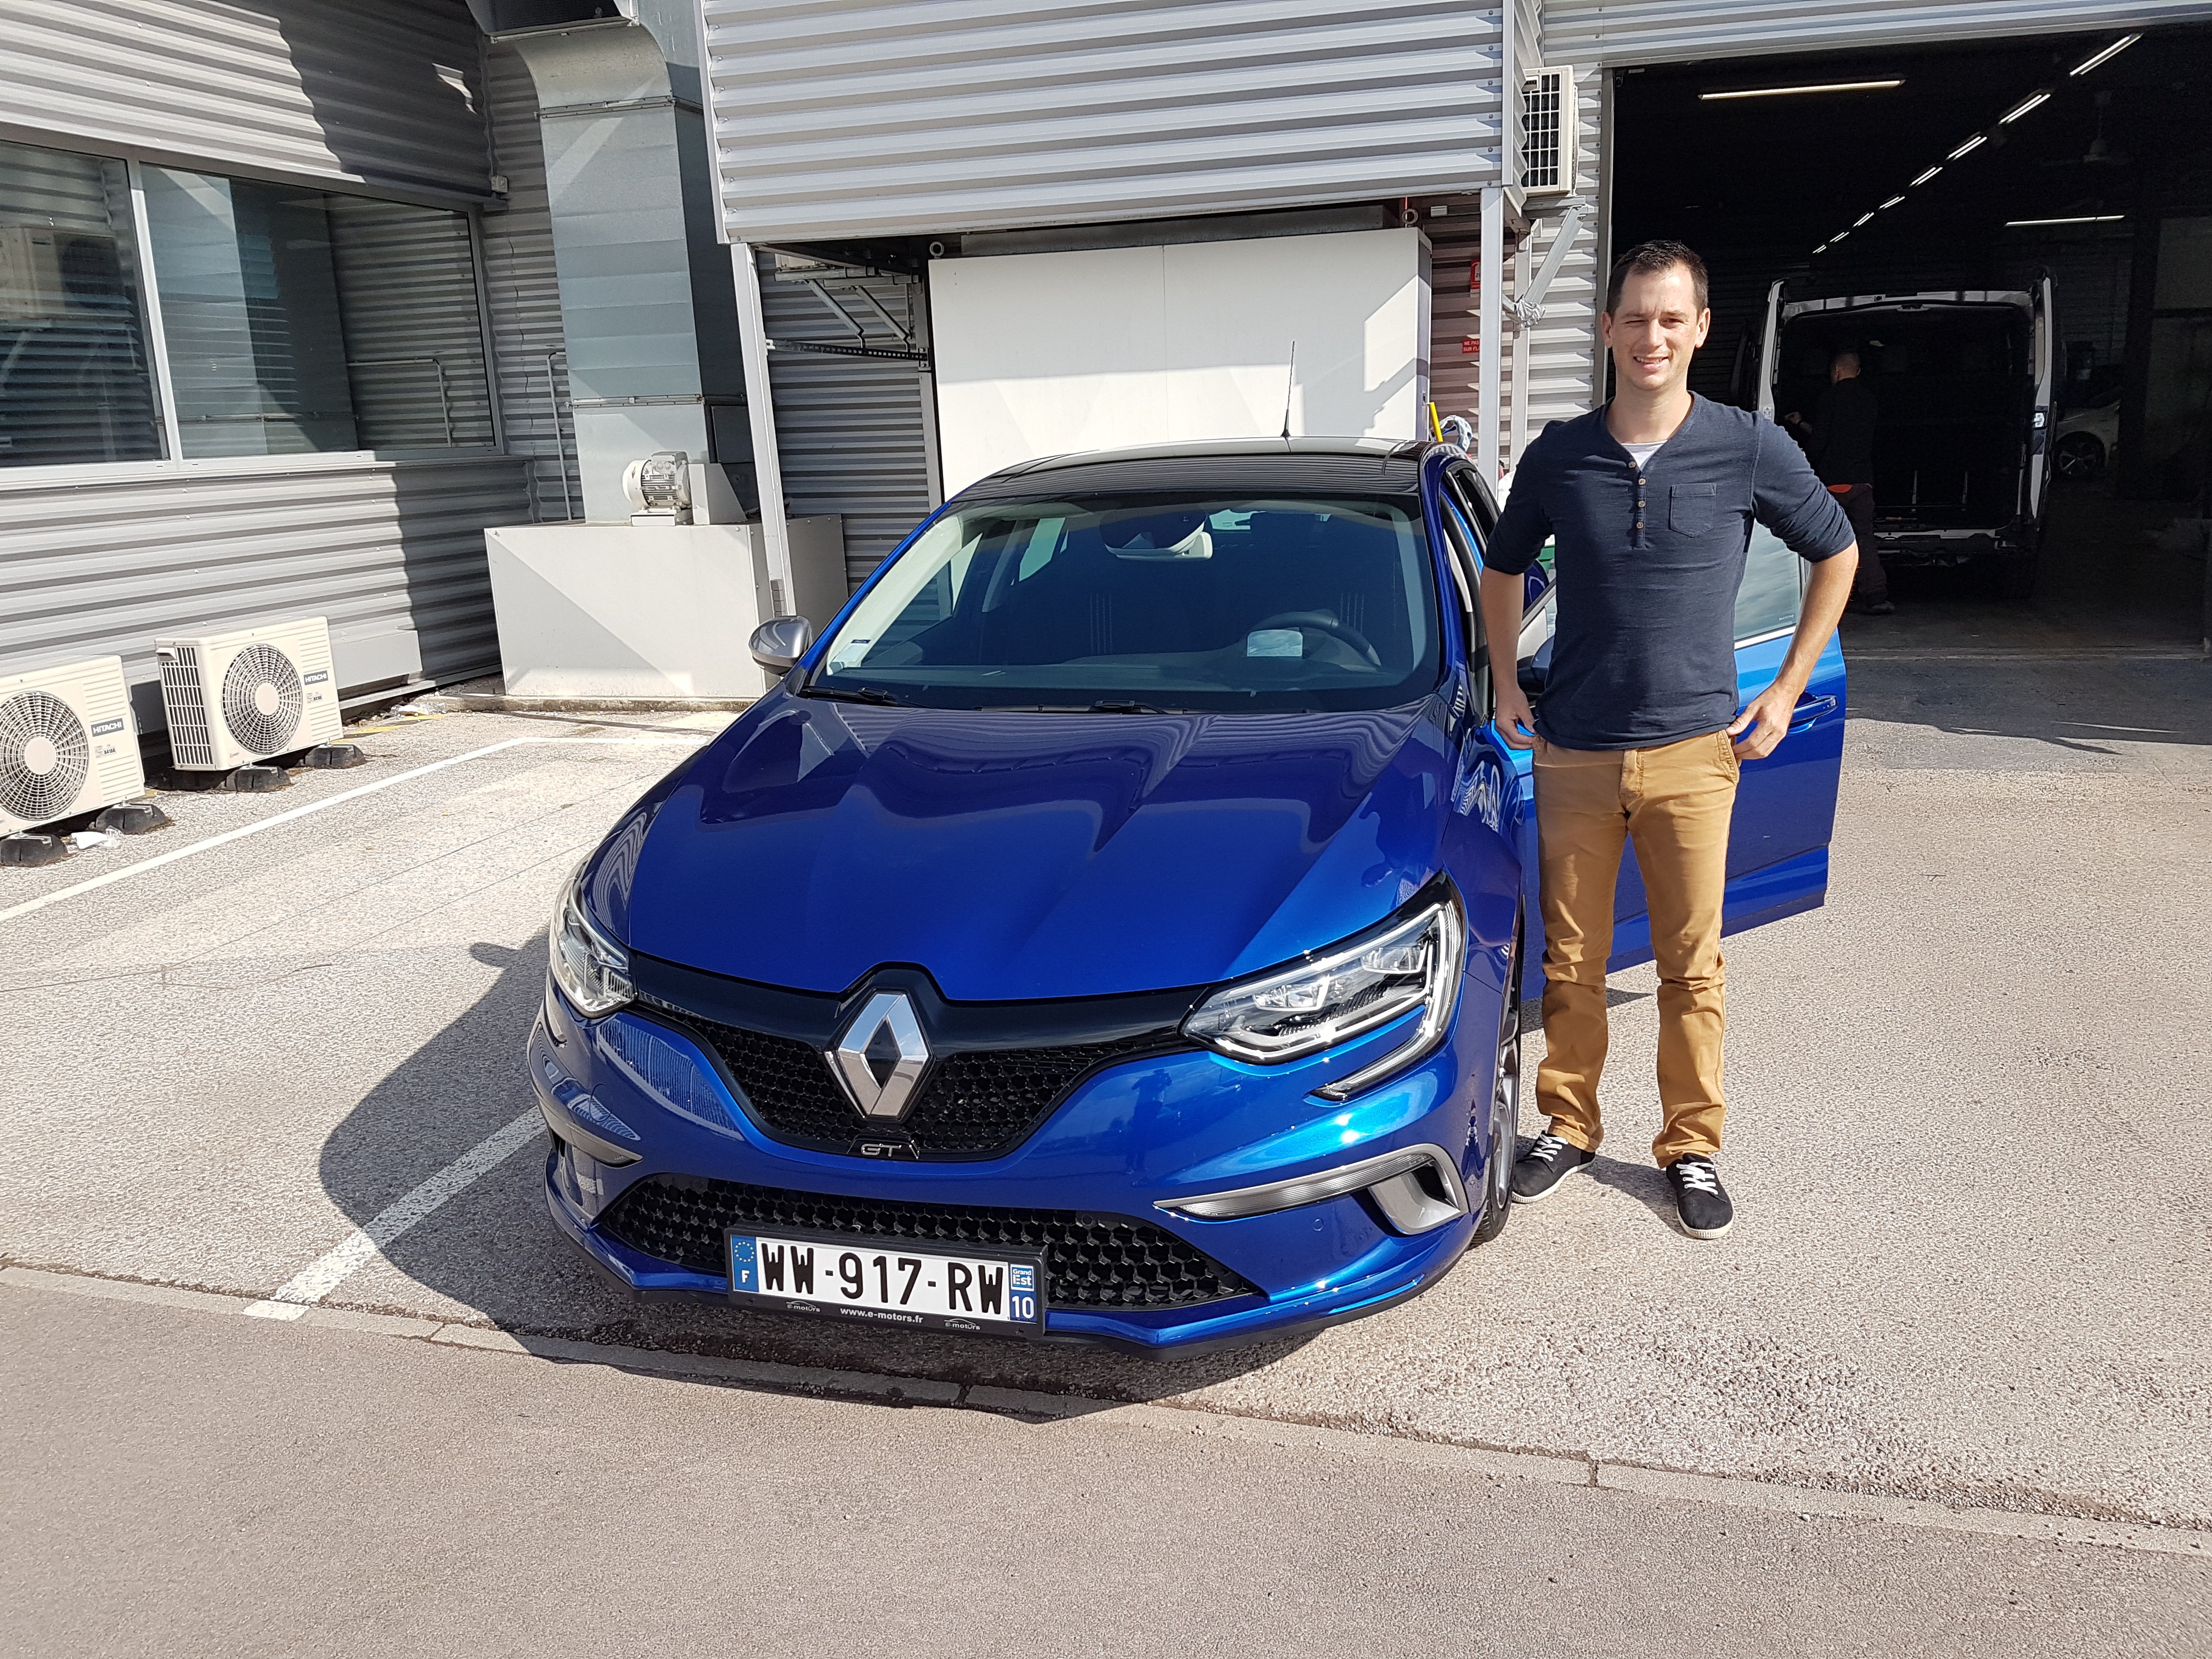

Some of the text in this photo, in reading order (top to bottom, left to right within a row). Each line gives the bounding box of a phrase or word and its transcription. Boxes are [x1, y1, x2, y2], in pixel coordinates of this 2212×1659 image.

[305, 673, 327, 683] HITACHI
[93, 721, 122, 734] HITACHI
[861, 1143, 902, 1157] GT
[741, 1243, 1003, 1314] F WW-917-RW
[1013, 1274, 1032, 1286] Est
[787, 1304, 821, 1313] e-motors
[1012, 1295, 1034, 1319] 10
[840, 1307, 923, 1324] www.e-motors.fr
[945, 1322, 980, 1330] e-motors
